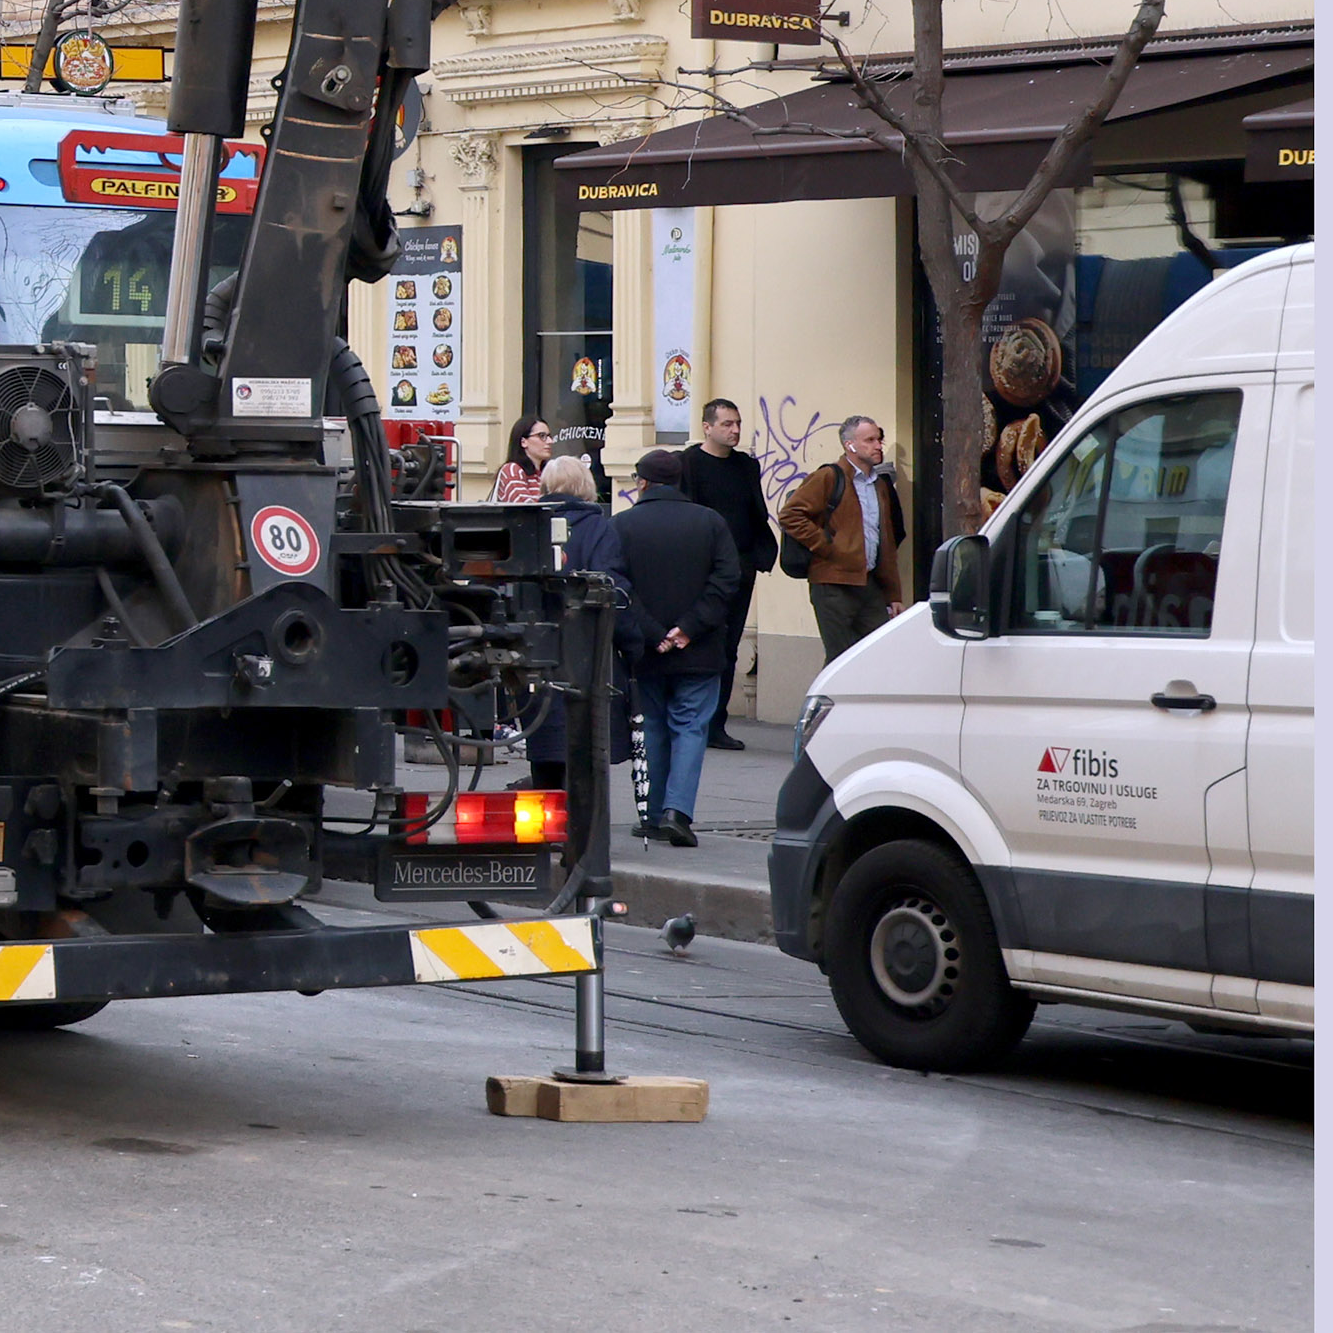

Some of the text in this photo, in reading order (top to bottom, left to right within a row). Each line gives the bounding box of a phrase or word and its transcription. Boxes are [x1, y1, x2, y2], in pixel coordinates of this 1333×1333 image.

[709, 9, 814, 30] DUBRAVICA
[101, 179, 231, 201] PALFINR
[578, 182, 658, 200] DUBRAVICA
[104, 268, 152, 312] 14
[559, 426, 603, 441] CHICKEN
[269, 524, 302, 552] 80
[1073, 748, 1118, 778] fibis
[1037, 778, 1050, 791] ZA
[1052, 779, 1107, 795] TRGOVINU
[1116, 785, 1158, 800] USLUGE
[1090, 798, 1118, 811] Zagreb
[1069, 812, 1078, 824] ZA
[393, 860, 536, 884] Mercedes-Benz
